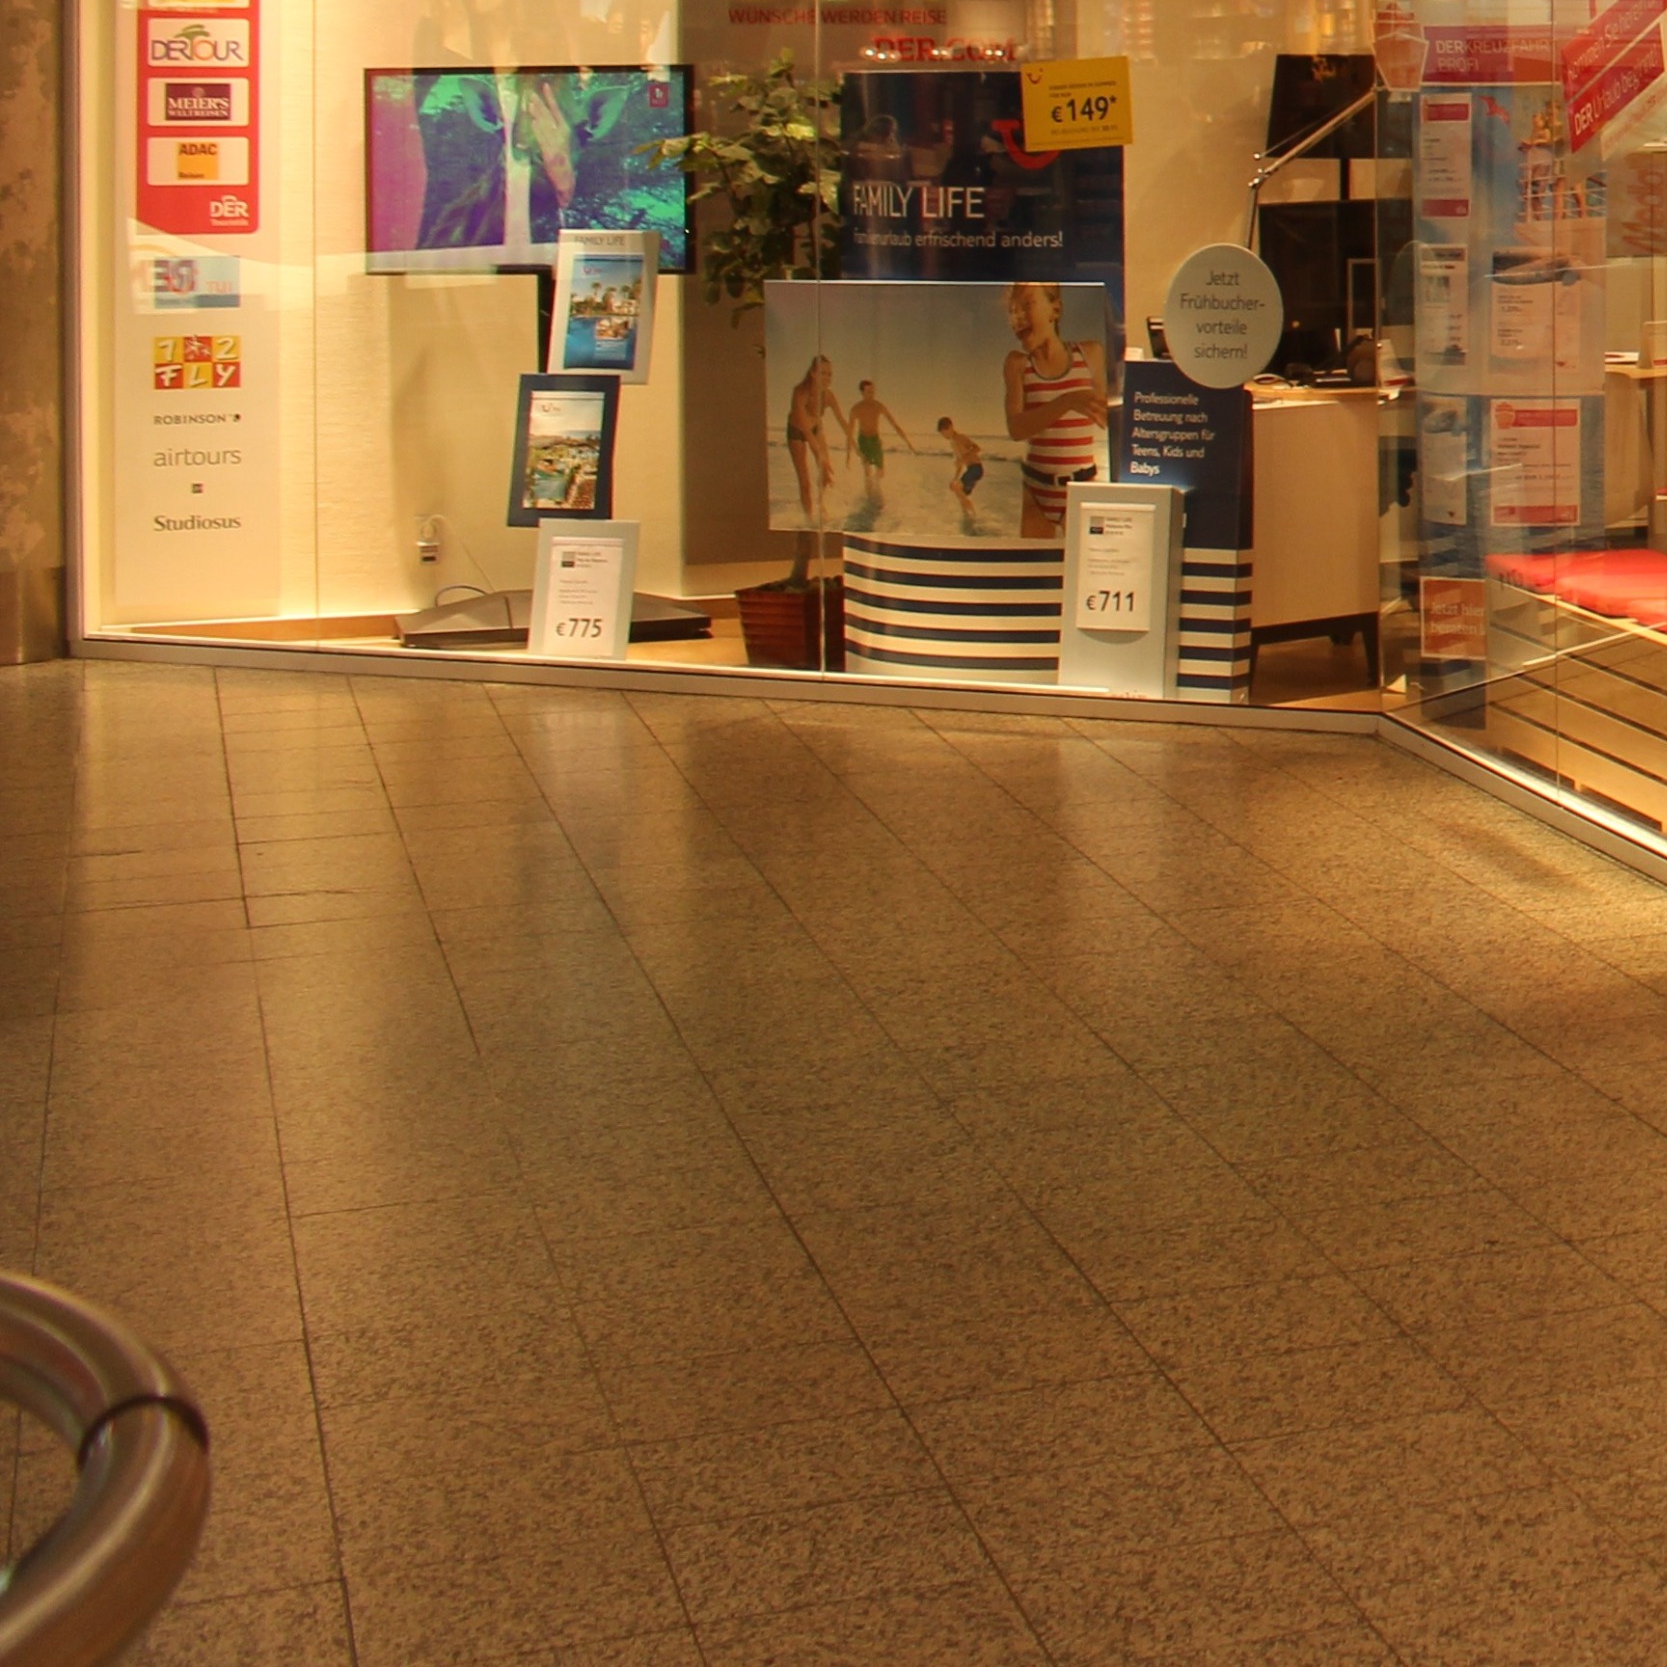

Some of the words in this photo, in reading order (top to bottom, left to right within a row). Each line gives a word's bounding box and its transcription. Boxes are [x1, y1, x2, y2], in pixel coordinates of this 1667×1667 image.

[728, 6, 816, 24] WÜNSCHE
[820, 8, 898, 24] WERDEN
[900, 8, 947, 24] REISE
[151, 36, 244, 61] DERTOUR
[1438, 57, 1479, 72] PROFI
[1575, 103, 1593, 135] DER
[179, 144, 218, 155] ADAC
[210, 201, 249, 218] DER
[854, 185, 913, 218] FAMILY
[922, 187, 985, 218] LIFE
[574, 236, 603, 247] FAMILY
[606, 236, 626, 247] LIFE
[915, 231, 996, 247] erfrischend
[1001, 231, 1063, 247] anders!
[1206, 271, 1239, 286] Jetzt
[1180, 293, 1265, 311] Frühbucher-
[1196, 320, 1247, 334] vorteile
[1194, 344, 1248, 359] sichern!
[1134, 392, 1199, 406] Professionelle
[153, 414, 226, 425] ROBINSON
[1133, 409, 1183, 425] Betreuung
[1185, 412, 1208, 423] nach
[1132, 427, 1198, 442] Altersgruppen
[1201, 429, 1215, 441] für
[153, 448, 242, 467] airtours
[1131, 444, 1160, 458] Teens,
[1163, 446, 1183, 458] Kids
[1186, 447, 1205, 458] und
[1130, 461, 1160, 477] Babys
[154, 515, 242, 532] Studiosus
